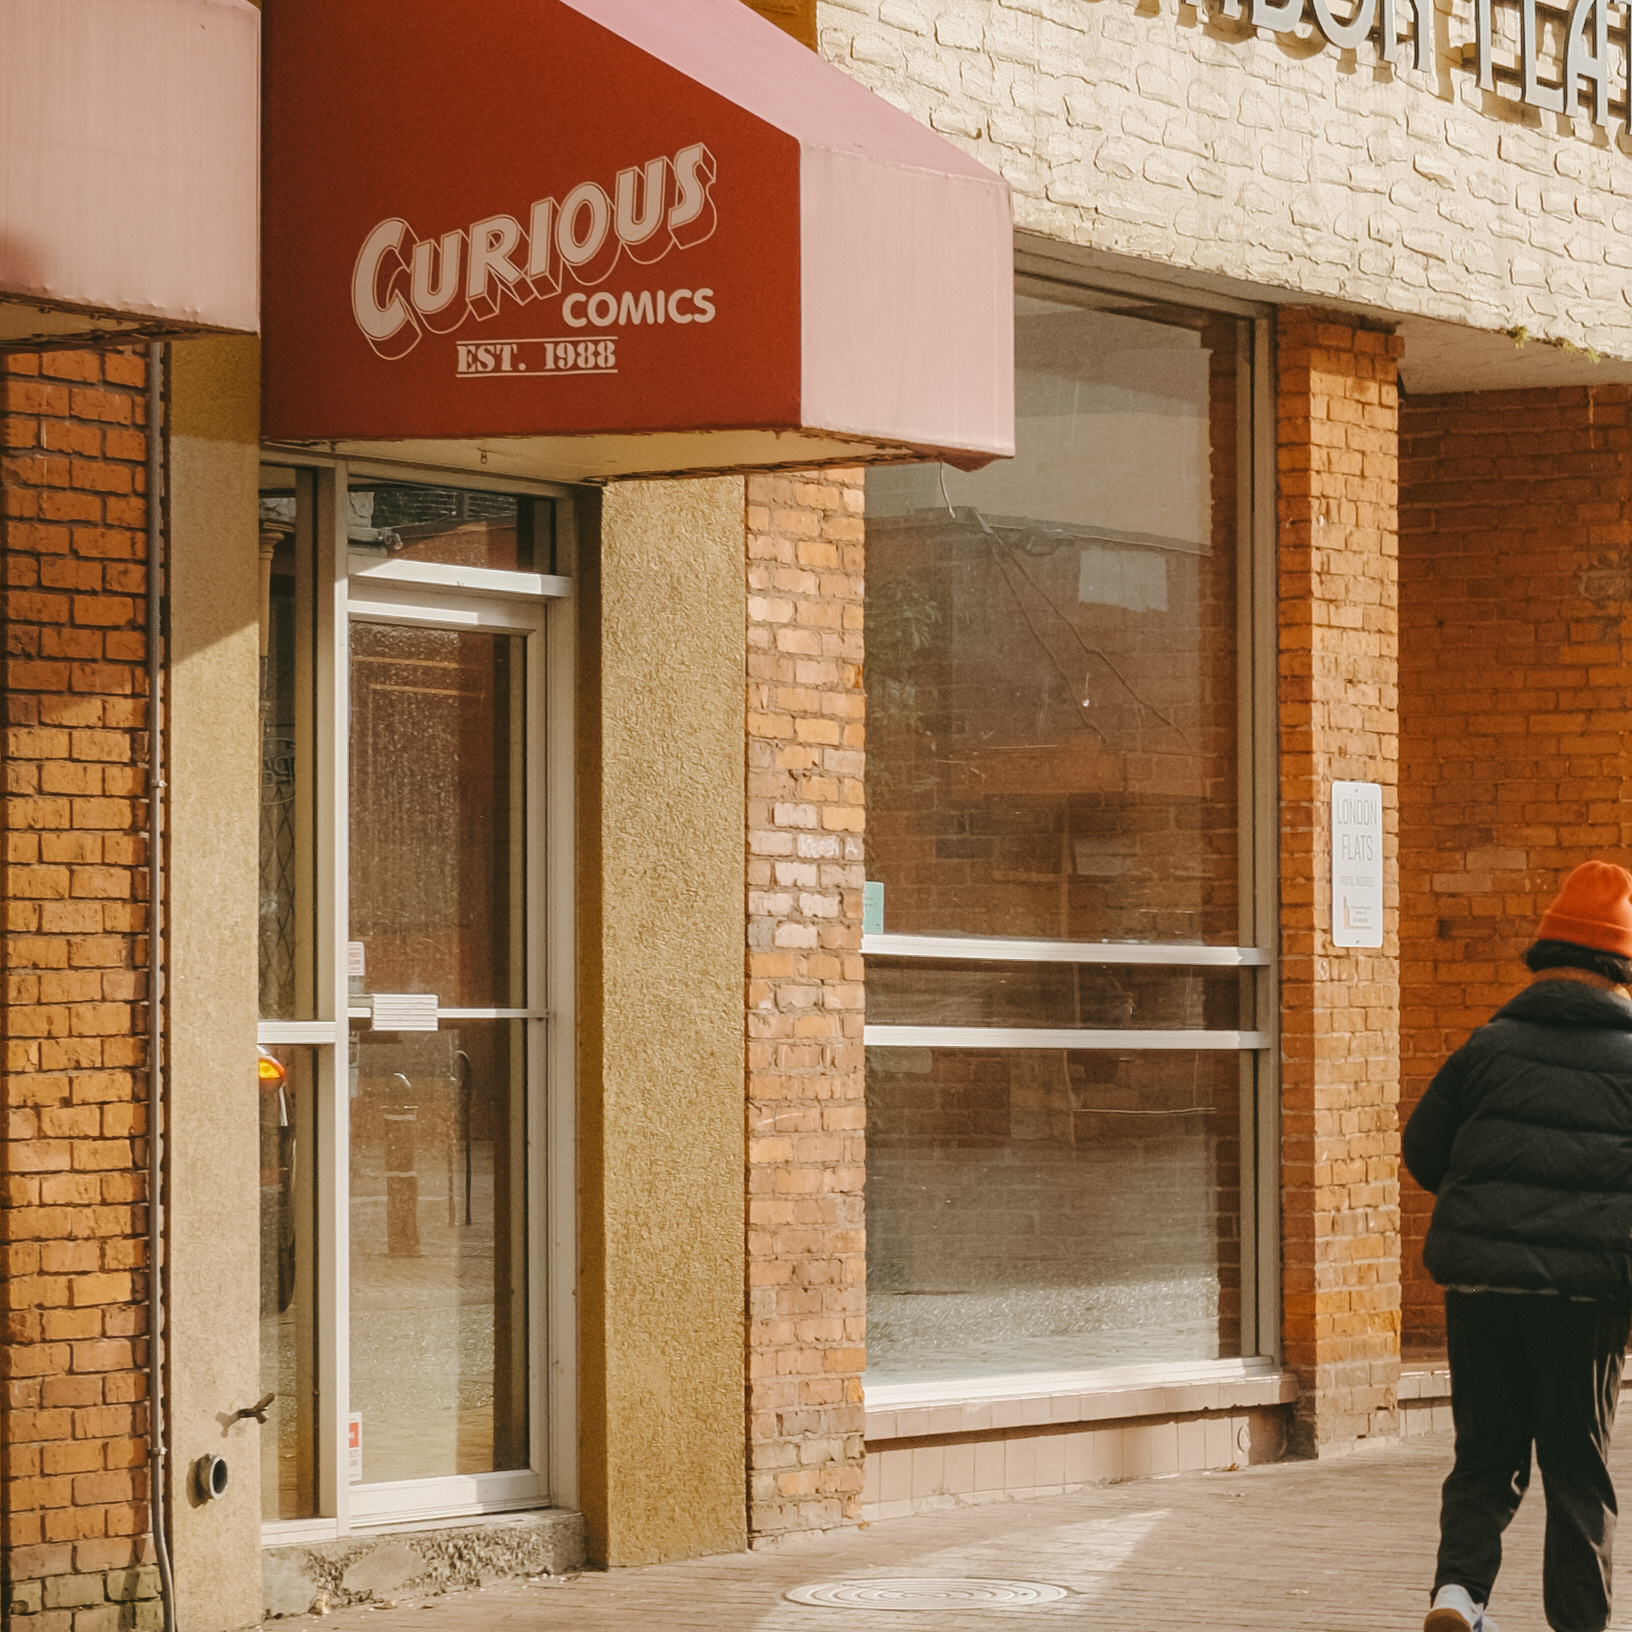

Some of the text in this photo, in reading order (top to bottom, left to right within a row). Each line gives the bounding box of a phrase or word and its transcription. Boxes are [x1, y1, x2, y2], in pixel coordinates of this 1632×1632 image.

[352, 142, 717, 360] CURIOUS
[562, 288, 716, 328] COMICS
[456, 340, 616, 373] EST. 1988
[1336, 798, 1378, 827] LONDON
[1341, 833, 1374, 861] FLATS
